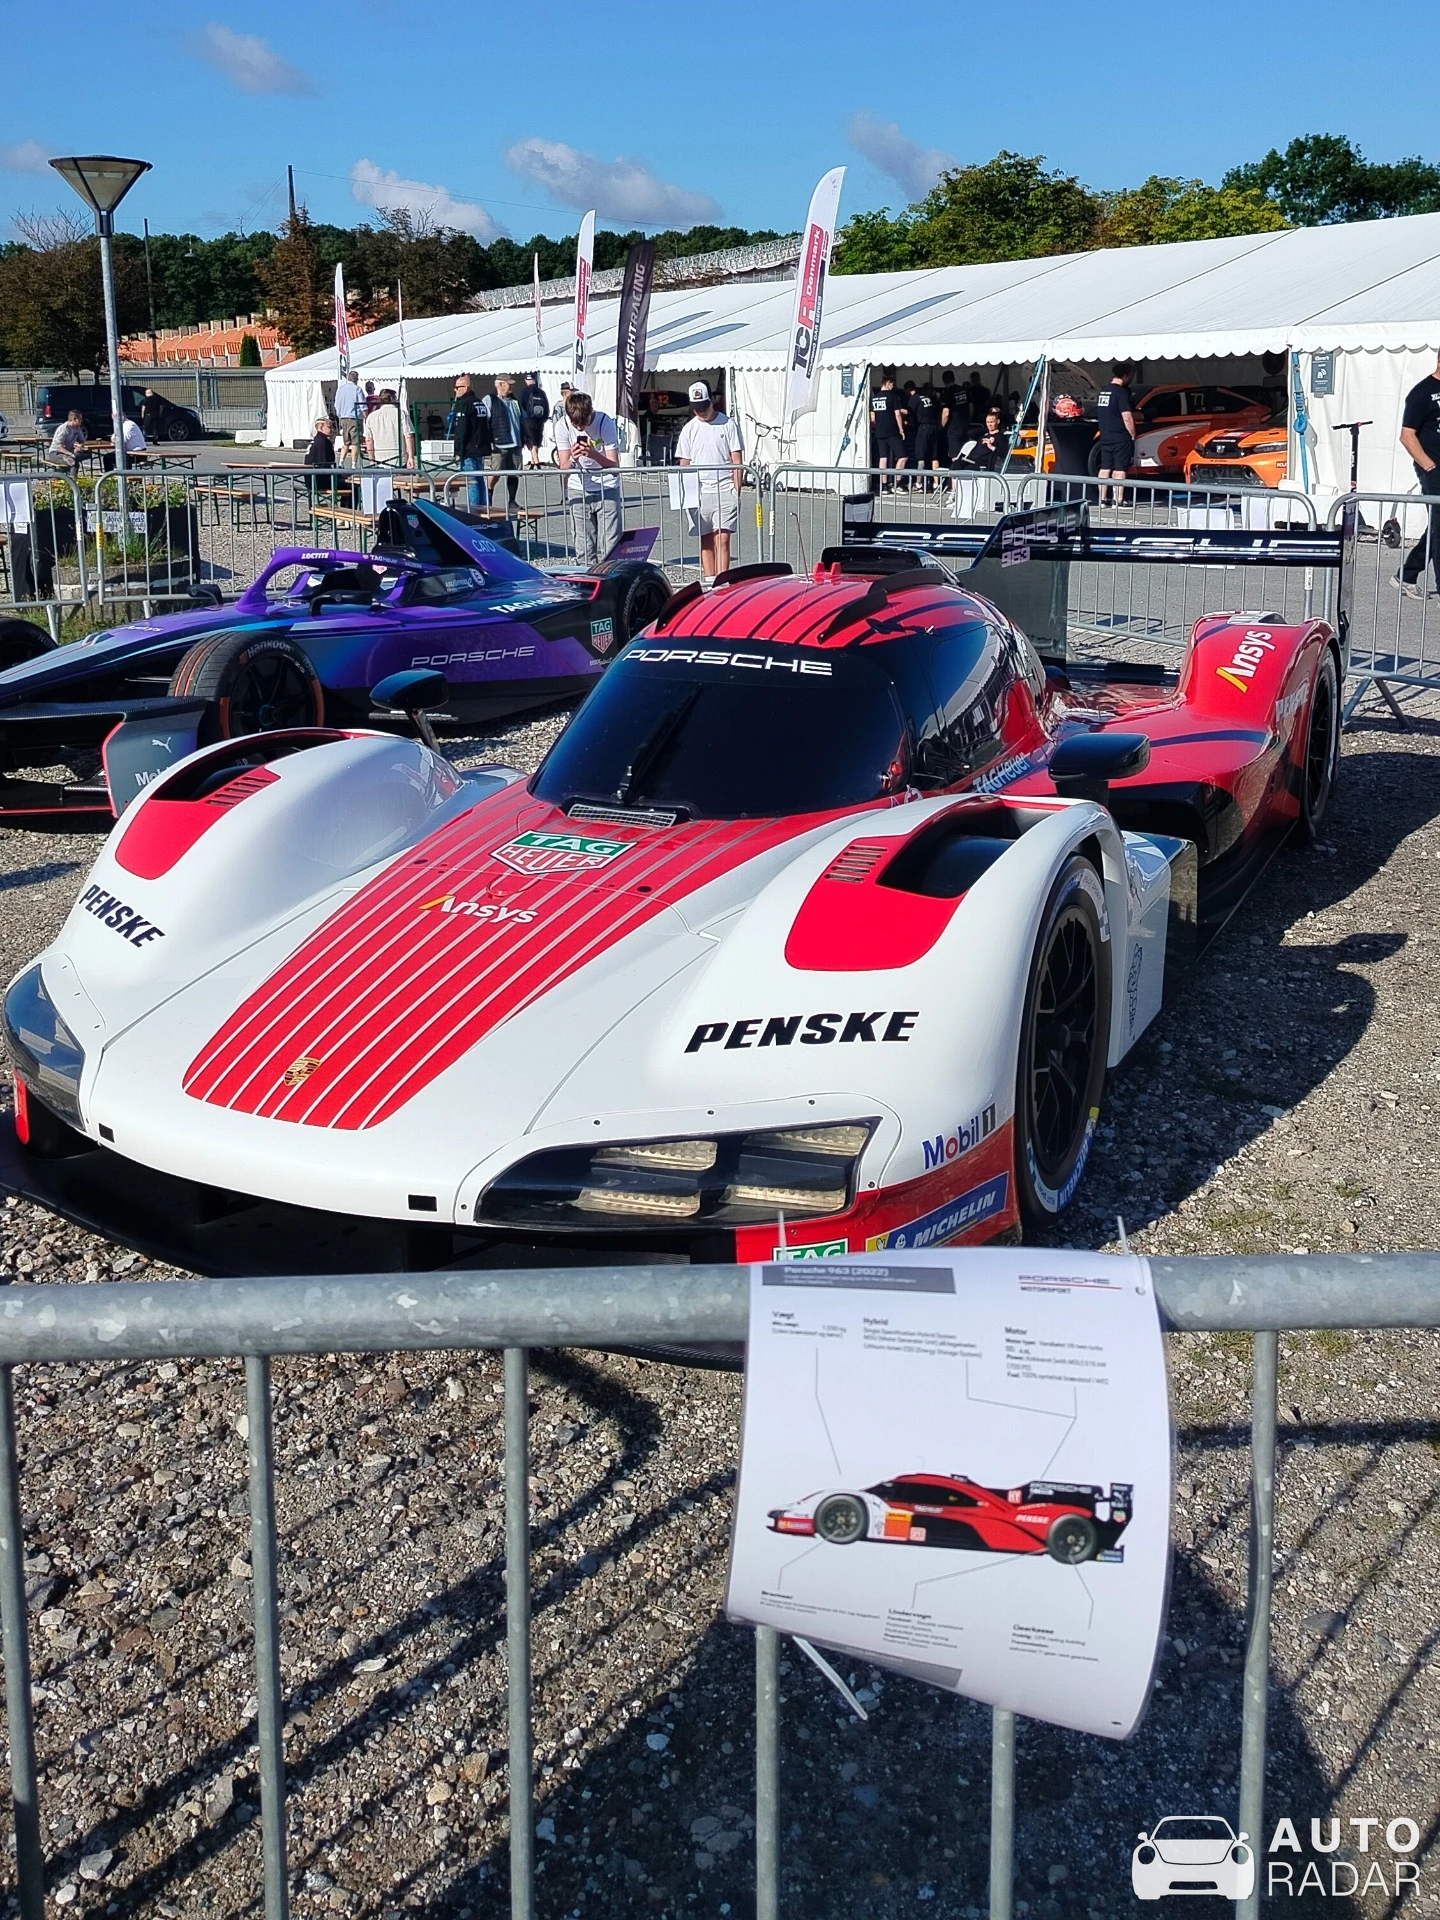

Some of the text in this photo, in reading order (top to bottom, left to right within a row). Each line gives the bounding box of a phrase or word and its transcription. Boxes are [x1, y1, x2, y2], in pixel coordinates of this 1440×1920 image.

[806, 229, 821, 296] Denmark
[1200, 468, 1240, 479] CIVIC
[1001, 513, 1077, 549] PORSCHE
[301, 552, 330, 560] LOCTITE
[471, 539, 496, 553] CATO
[1001, 546, 1031, 569] 963
[592, 620, 611, 632] TAG
[592, 632, 614, 649] HEUER
[411, 645, 536, 668] PORSCHE
[622, 649, 833, 676] PORSCHE
[1216, 630, 1276, 693] Ansys
[531, 833, 620, 854] TAG
[501, 846, 604, 871] HEUER
[79, 884, 166, 948] PENSKE
[418, 895, 539, 924] Ansys
[684, 1011, 920, 1054] PENSKE
[922, 1103, 996, 1170] Mobil 1
[913, 1190, 996, 1248] MICHELIN
[784, 1266, 889, 1277] Porsche 963 (2022)
[1015, 1514, 1050, 1524] PENSKE
